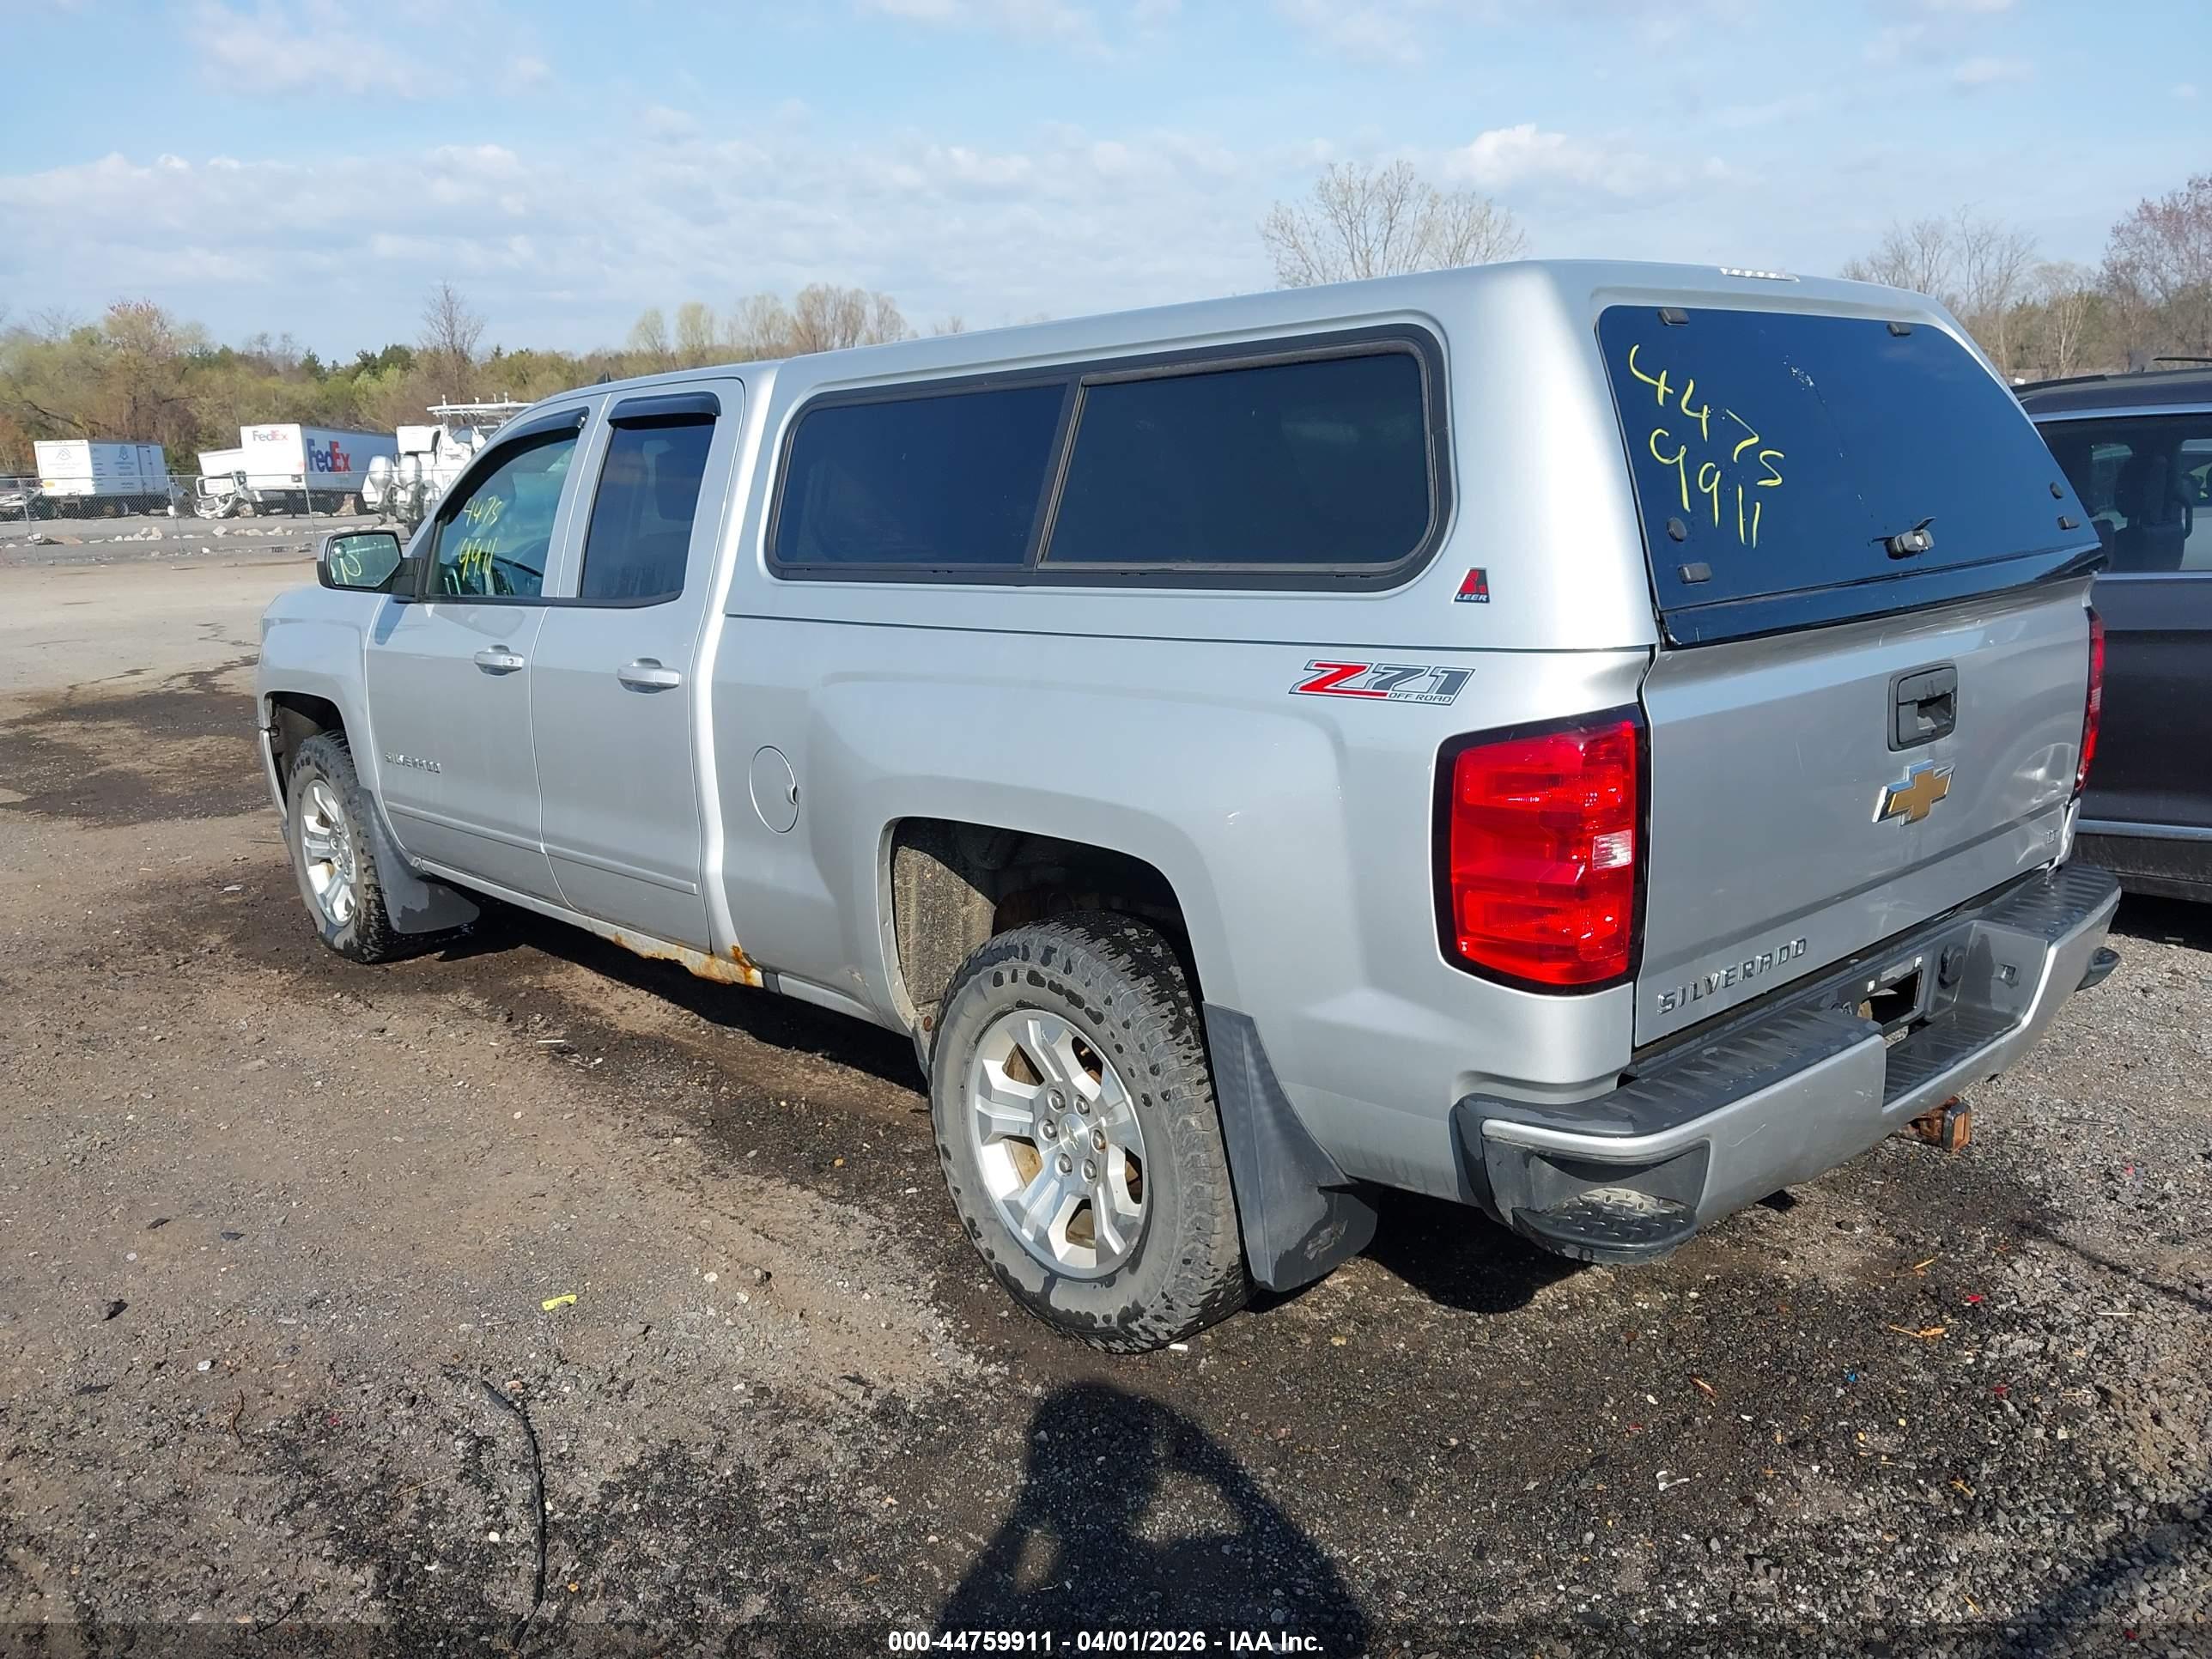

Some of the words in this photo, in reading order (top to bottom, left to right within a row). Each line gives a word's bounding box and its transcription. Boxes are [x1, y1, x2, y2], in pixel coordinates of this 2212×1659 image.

[252, 430, 289, 441] FedEx
[1629, 343, 1784, 487] 4475
[307, 438, 350, 472] FedEx
[1650, 428, 1760, 549] 9911
[459, 537, 498, 581] 9911
[1456, 593, 1488, 602] LEER
[1288, 659, 1475, 706] Z71
[1416, 694, 1452, 702] ROAD
[1656, 937, 1807, 1015] SILVERADO
